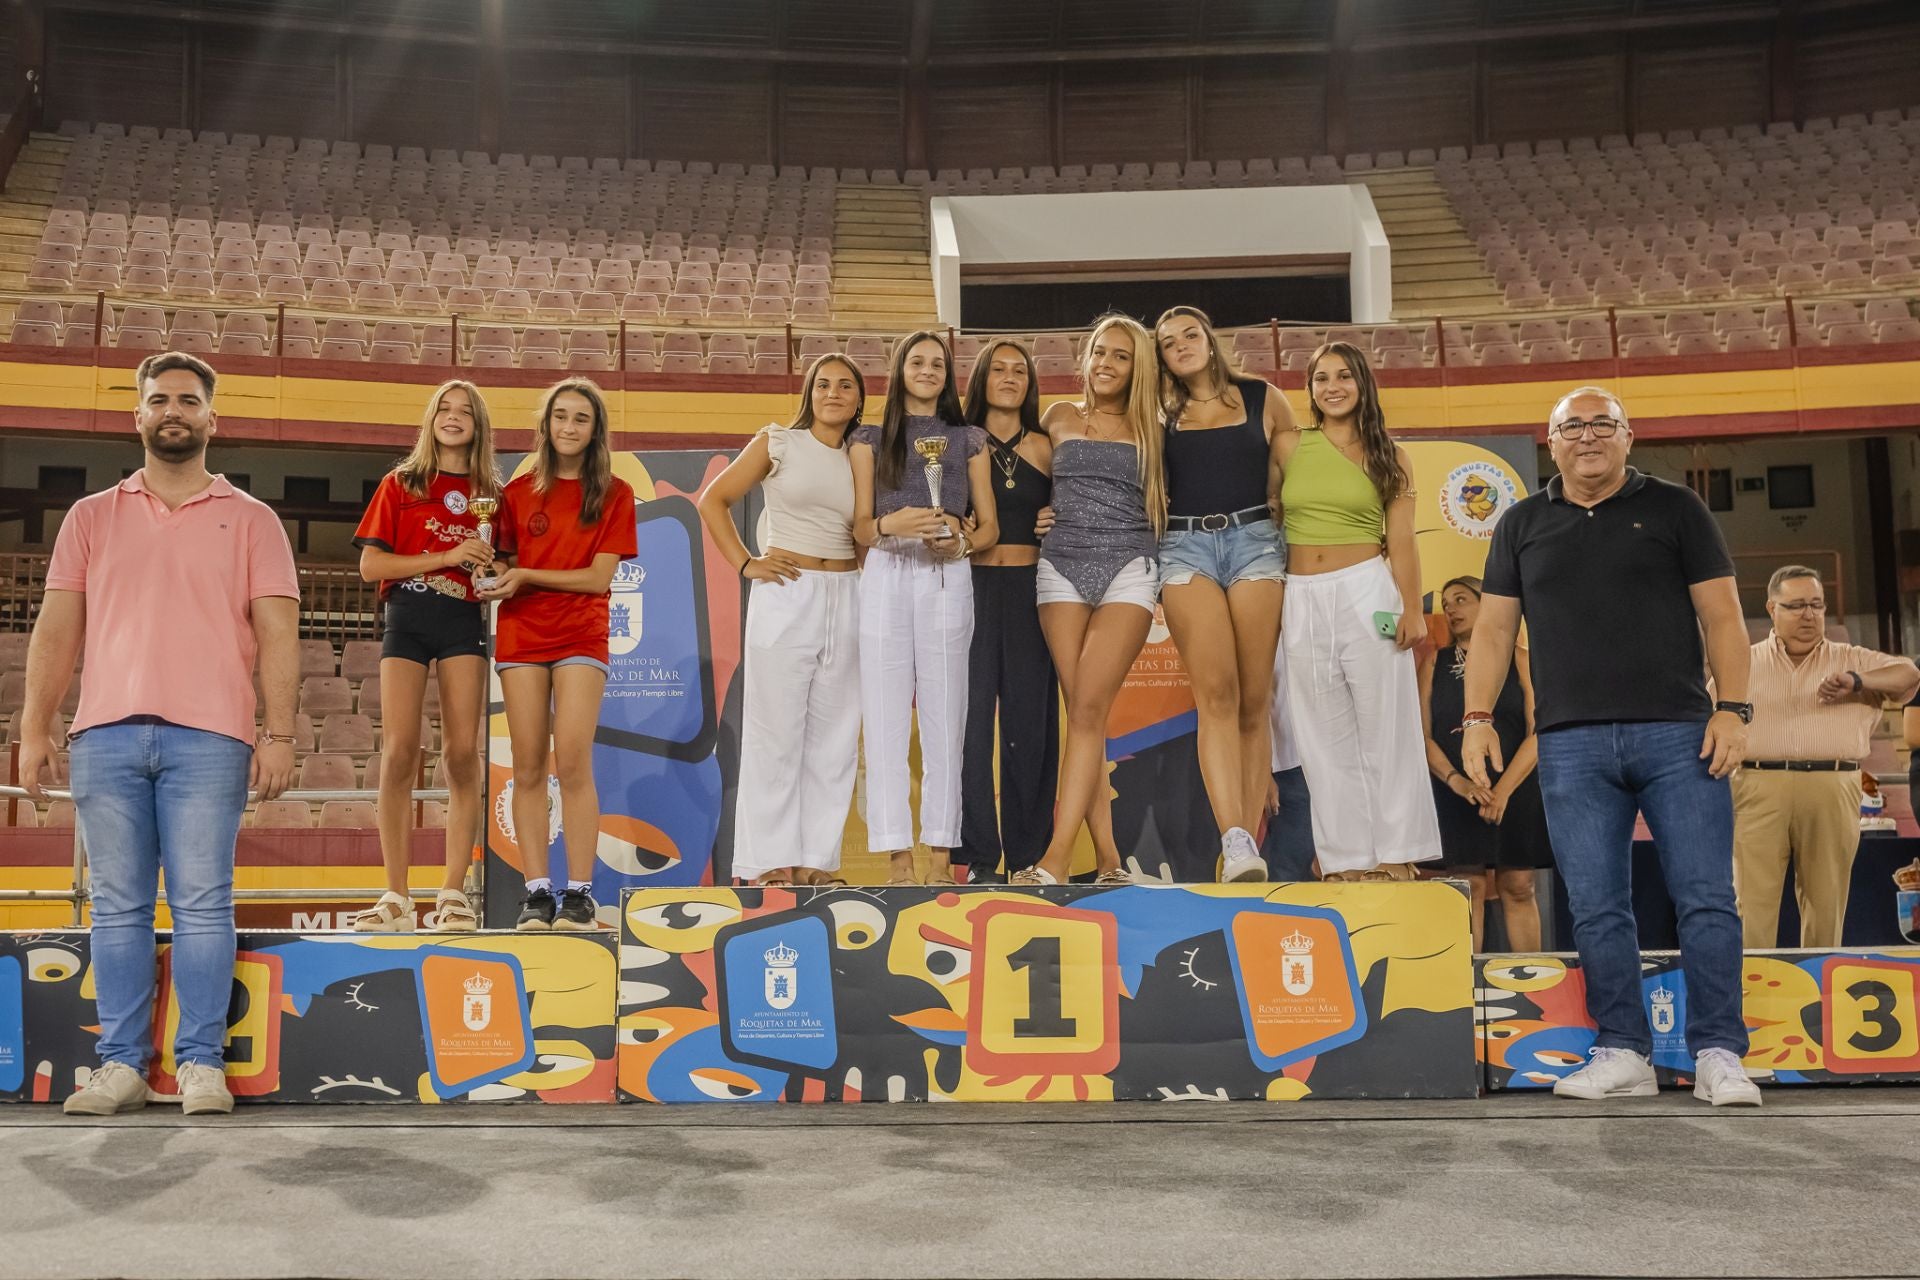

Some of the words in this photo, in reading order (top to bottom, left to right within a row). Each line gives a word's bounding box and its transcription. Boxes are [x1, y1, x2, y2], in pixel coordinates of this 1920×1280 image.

[1478, 530, 1494, 538] VID
[1142, 647, 1178, 655] AMIENT
[649, 657, 661, 666] DE
[1131, 660, 1159, 670] ETAS
[1164, 660, 1180, 670] DE
[629, 670, 644, 681] DE
[1121, 680, 1147, 688] portes,
[642, 690, 667, 699] Tiempo
[1006, 936, 1077, 1038] 1
[1259, 1004, 1302, 1013] ROQUETAS
[1305, 1005, 1315, 1013] DE
[1845, 980, 1902, 1052] 3
[740, 1018, 784, 1028] ROQUETAS
[787, 1019, 798, 1027] DE
